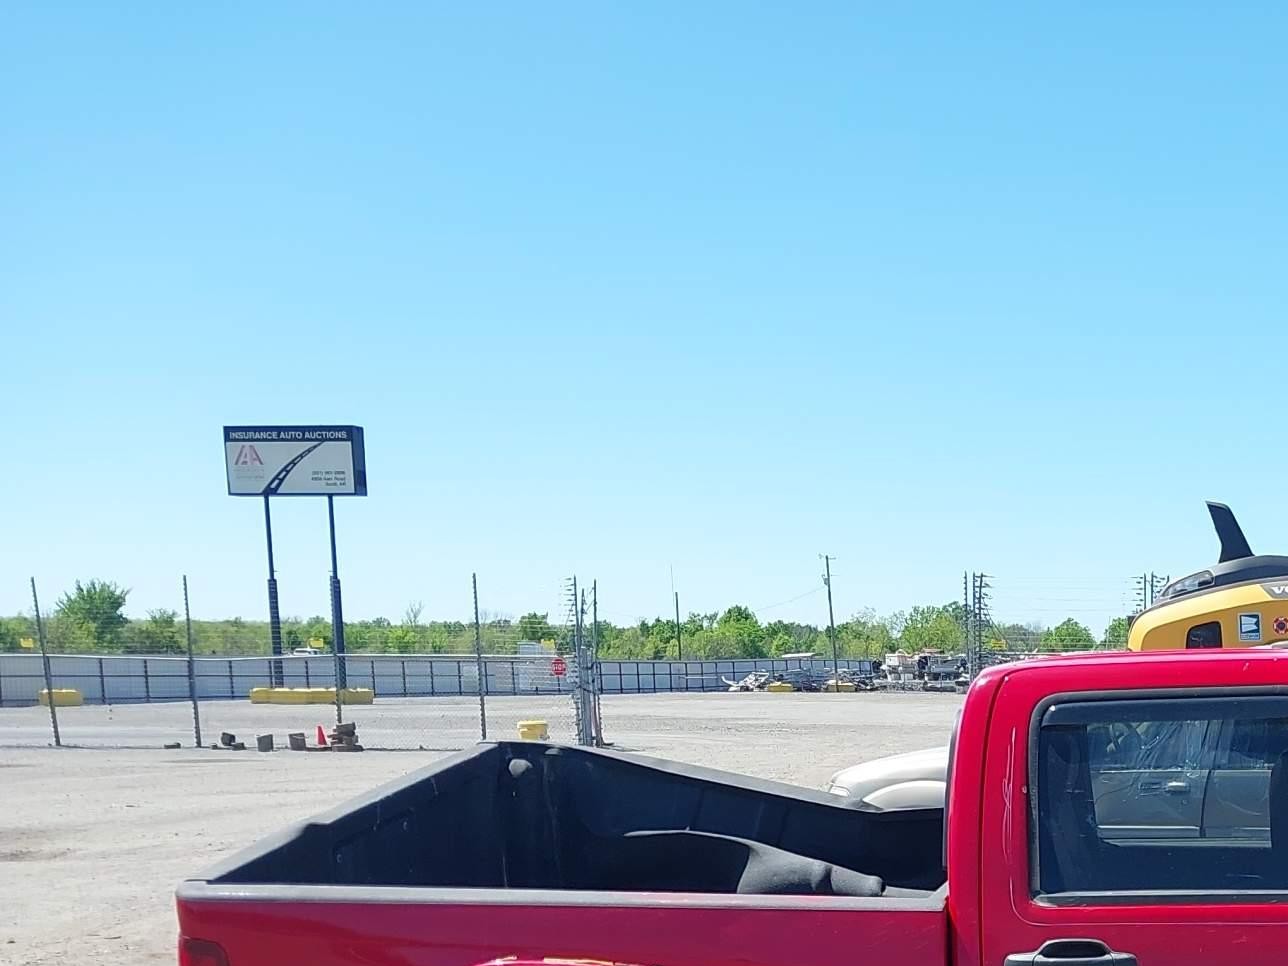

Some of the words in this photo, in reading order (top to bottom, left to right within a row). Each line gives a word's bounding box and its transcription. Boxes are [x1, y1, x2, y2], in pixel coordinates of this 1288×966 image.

[229, 431, 278, 439] INSURANCE
[279, 431, 302, 439] AUTO
[304, 430, 347, 439] AUCTIONS
